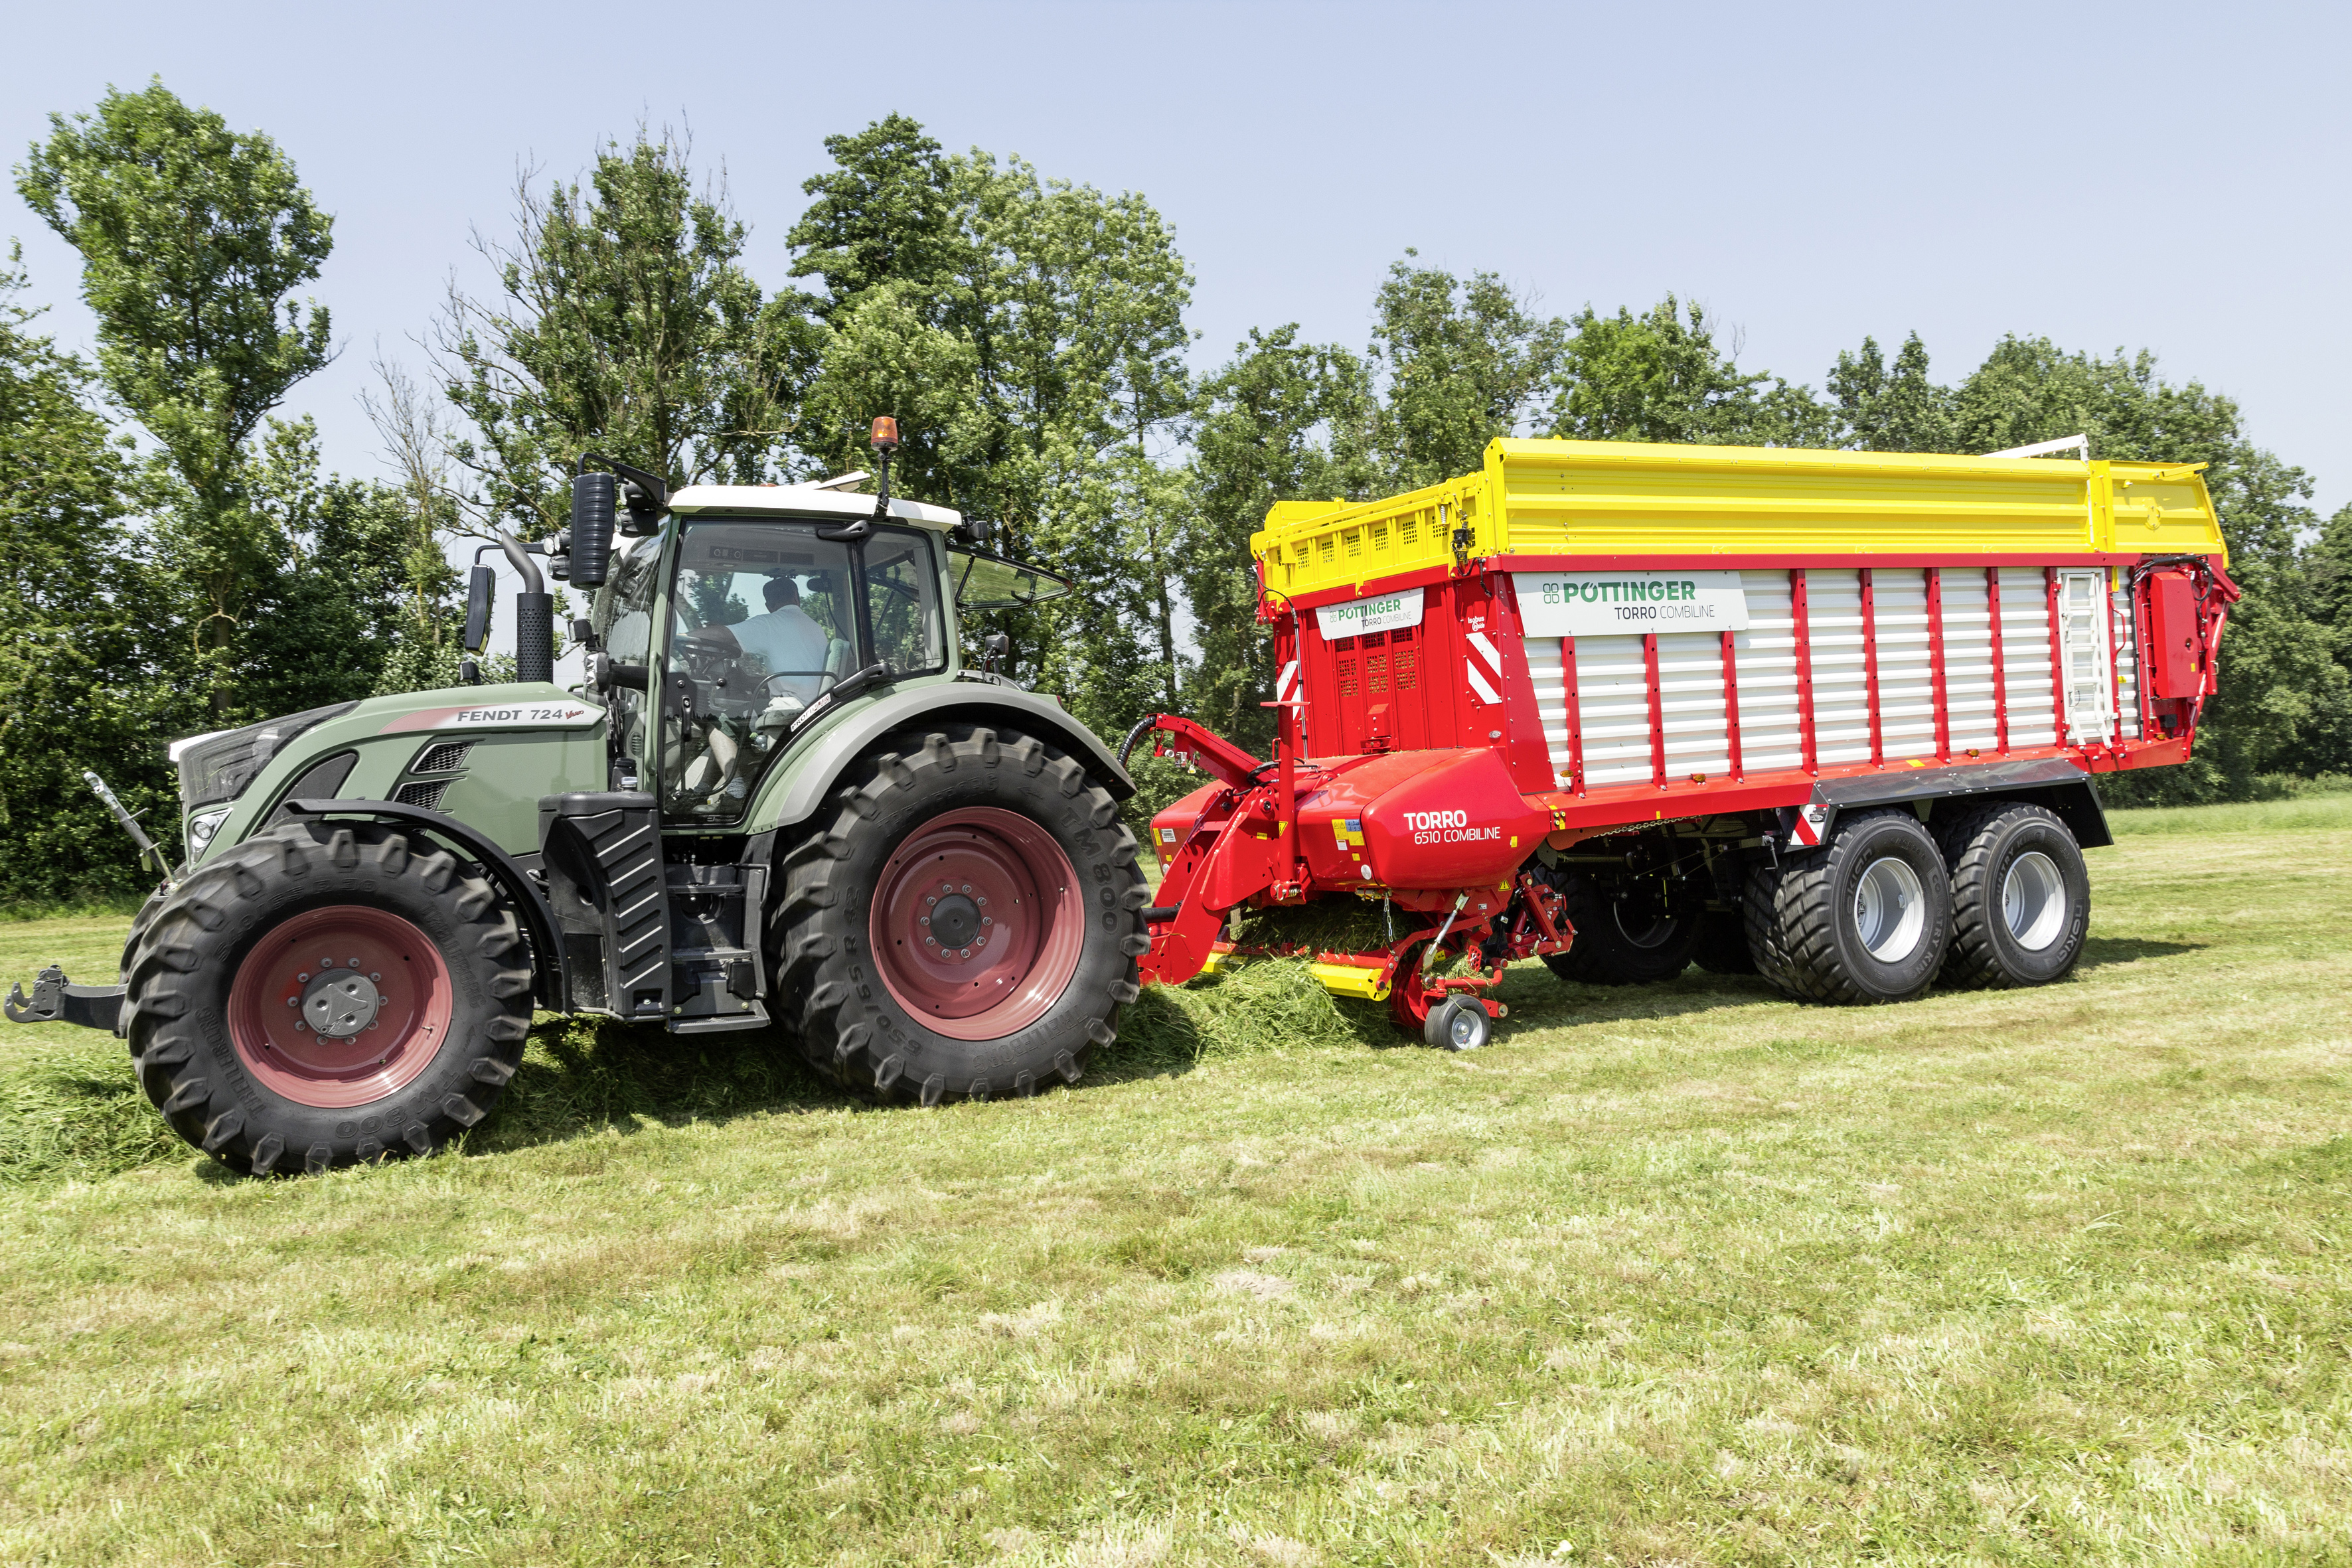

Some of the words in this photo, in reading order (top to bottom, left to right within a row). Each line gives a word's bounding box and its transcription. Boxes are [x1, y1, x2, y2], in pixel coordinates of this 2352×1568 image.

[1563, 581, 1696, 603] PÖTTINGER
[1338, 599, 1401, 621] PÖTTINGER
[1362, 617, 1382, 627] TORRO
[1383, 611, 1412, 624] COMBILINE
[1614, 606, 1657, 620] TORRO
[1660, 605, 1715, 619] COMBILINE
[457, 710, 522, 722] FENDT
[530, 709, 563, 719] 724
[1403, 810, 1467, 830] TORRO
[1414, 830, 1441, 845] 6510
[1443, 826, 1501, 842] COMBILINE
[1996, 847, 2014, 905] OUNTRY
[973, 1004, 1089, 1074] TRELLEBORG
